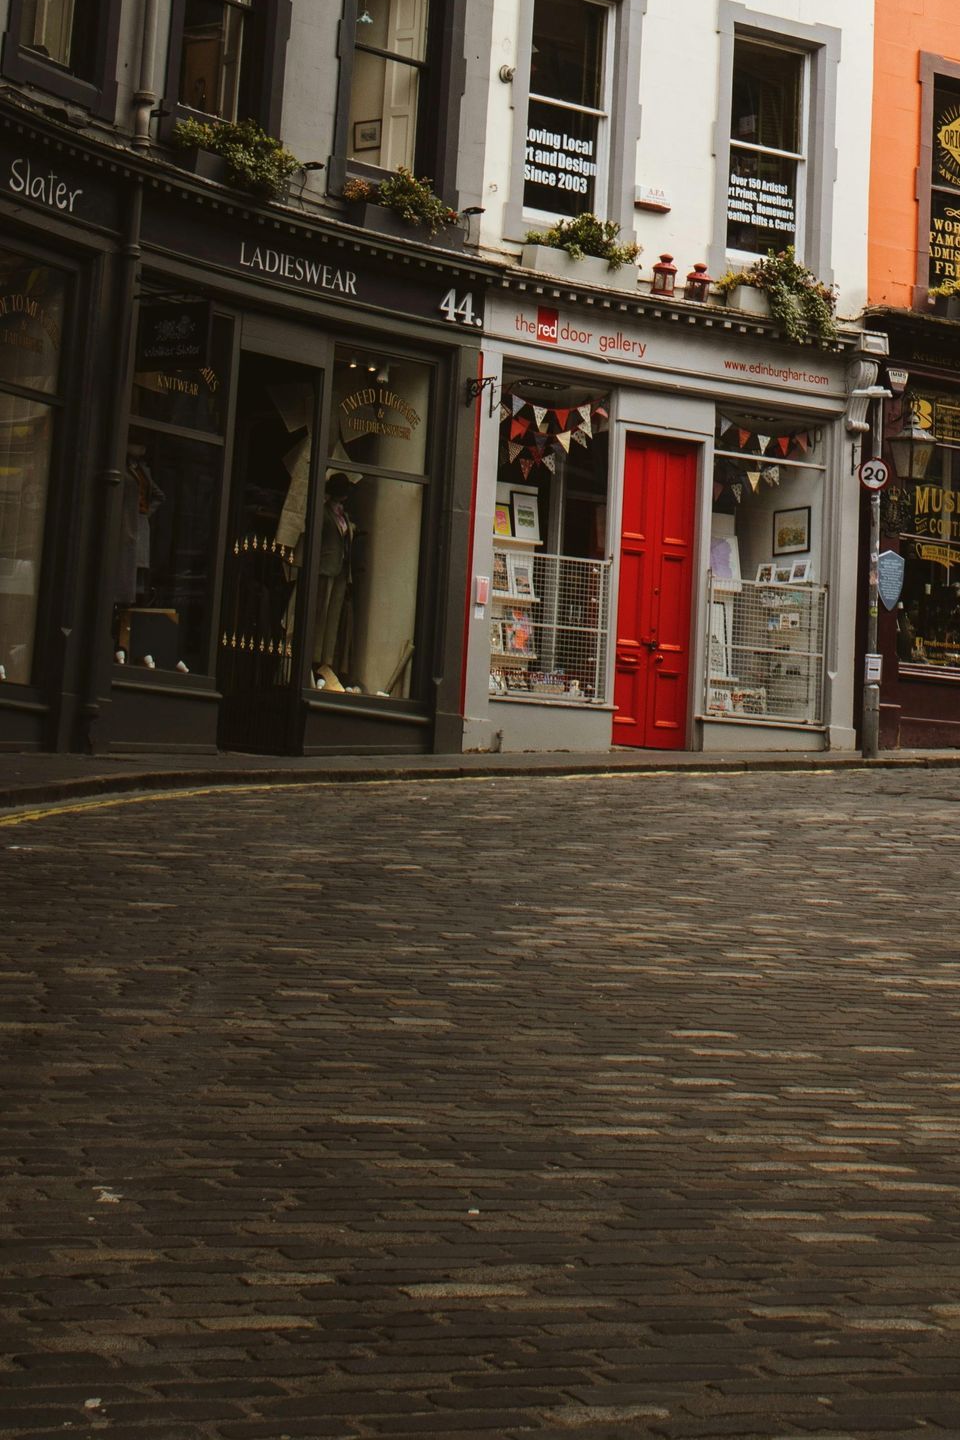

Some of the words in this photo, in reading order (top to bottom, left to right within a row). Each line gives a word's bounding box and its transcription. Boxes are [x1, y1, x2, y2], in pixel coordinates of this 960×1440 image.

[526, 128, 561, 150] oving
[562, 133, 593, 156] Local
[525, 146, 534, 162] rt
[535, 150, 558, 169] and
[558, 154, 598, 177] Design
[9, 158, 83, 212] Slater
[524, 165, 557, 187] Since
[558, 172, 588, 195] 2003
[731, 174, 748, 187] Over
[749, 177, 762, 190] 150
[762, 180, 788, 195] Artists!
[728, 198, 755, 213] ramics,
[757, 203, 794, 221] Homeware
[736, 186, 759, 202] Prints,
[759, 191, 793, 210] Jewellery,
[751, 213, 768, 227] Gifts
[769, 219, 775, 228] &
[775, 218, 797, 233] Cards
[239, 241, 357, 296] LADIESWEAR
[515, 313, 536, 333] the
[537, 320, 558, 339] red
[560, 322, 593, 344] door
[599, 332, 647, 357] gallery
[157, 374, 199, 397] KNITWEAR
[724, 359, 829, 386] www.edinburghart.com
[341, 388, 376, 416] TWEED
[864, 467, 886, 482] 20
